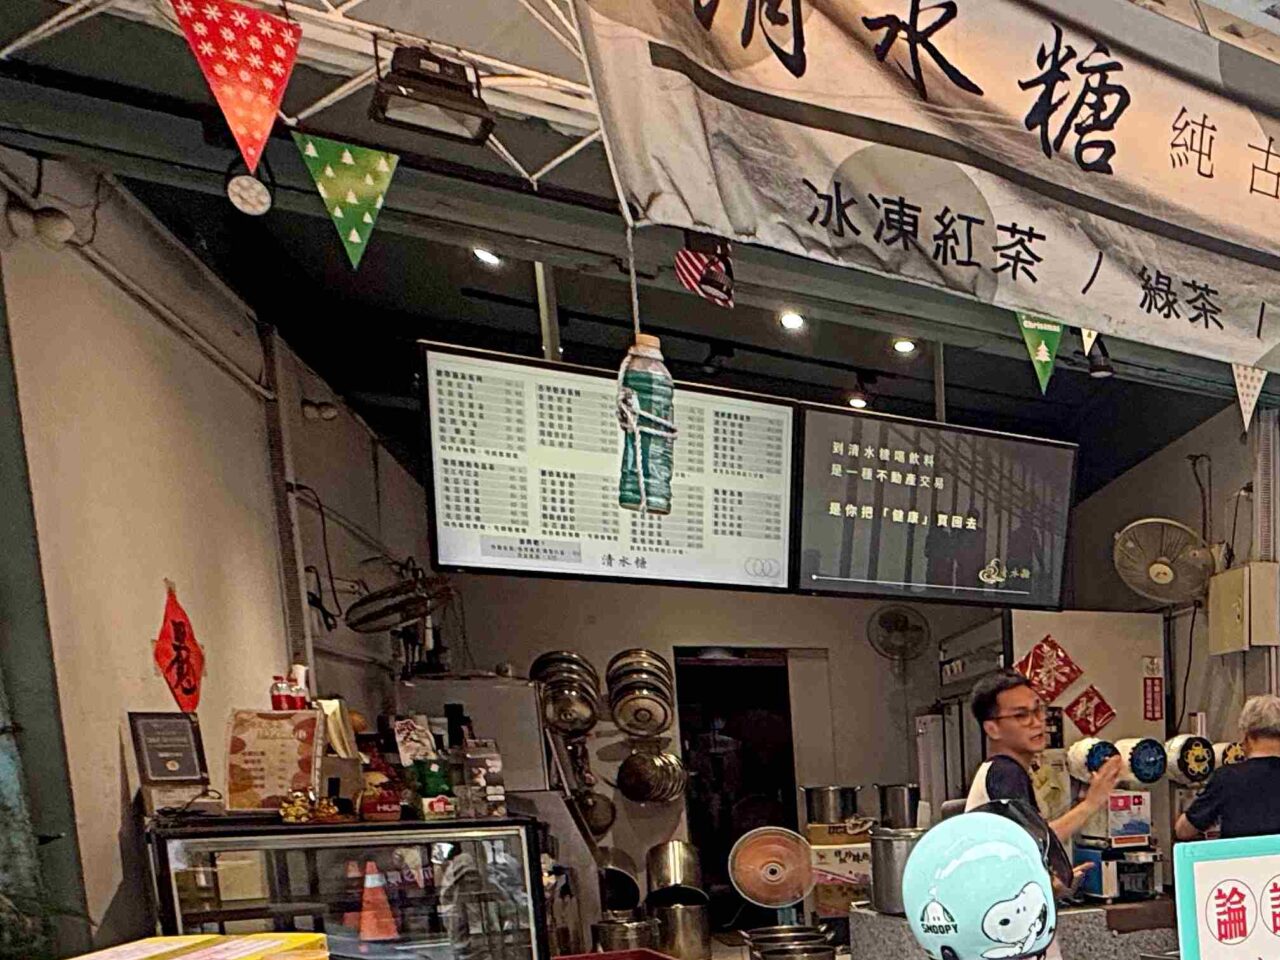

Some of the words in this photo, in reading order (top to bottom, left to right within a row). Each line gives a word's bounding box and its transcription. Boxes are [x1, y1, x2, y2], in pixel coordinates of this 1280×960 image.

[803, 178, 1046, 283] 冰凍紅茶
[1139, 265, 1224, 331] 綠茶
[831, 463, 944, 490] 是一種不動產交易
[921, 923, 958, 934] SNOOPY
